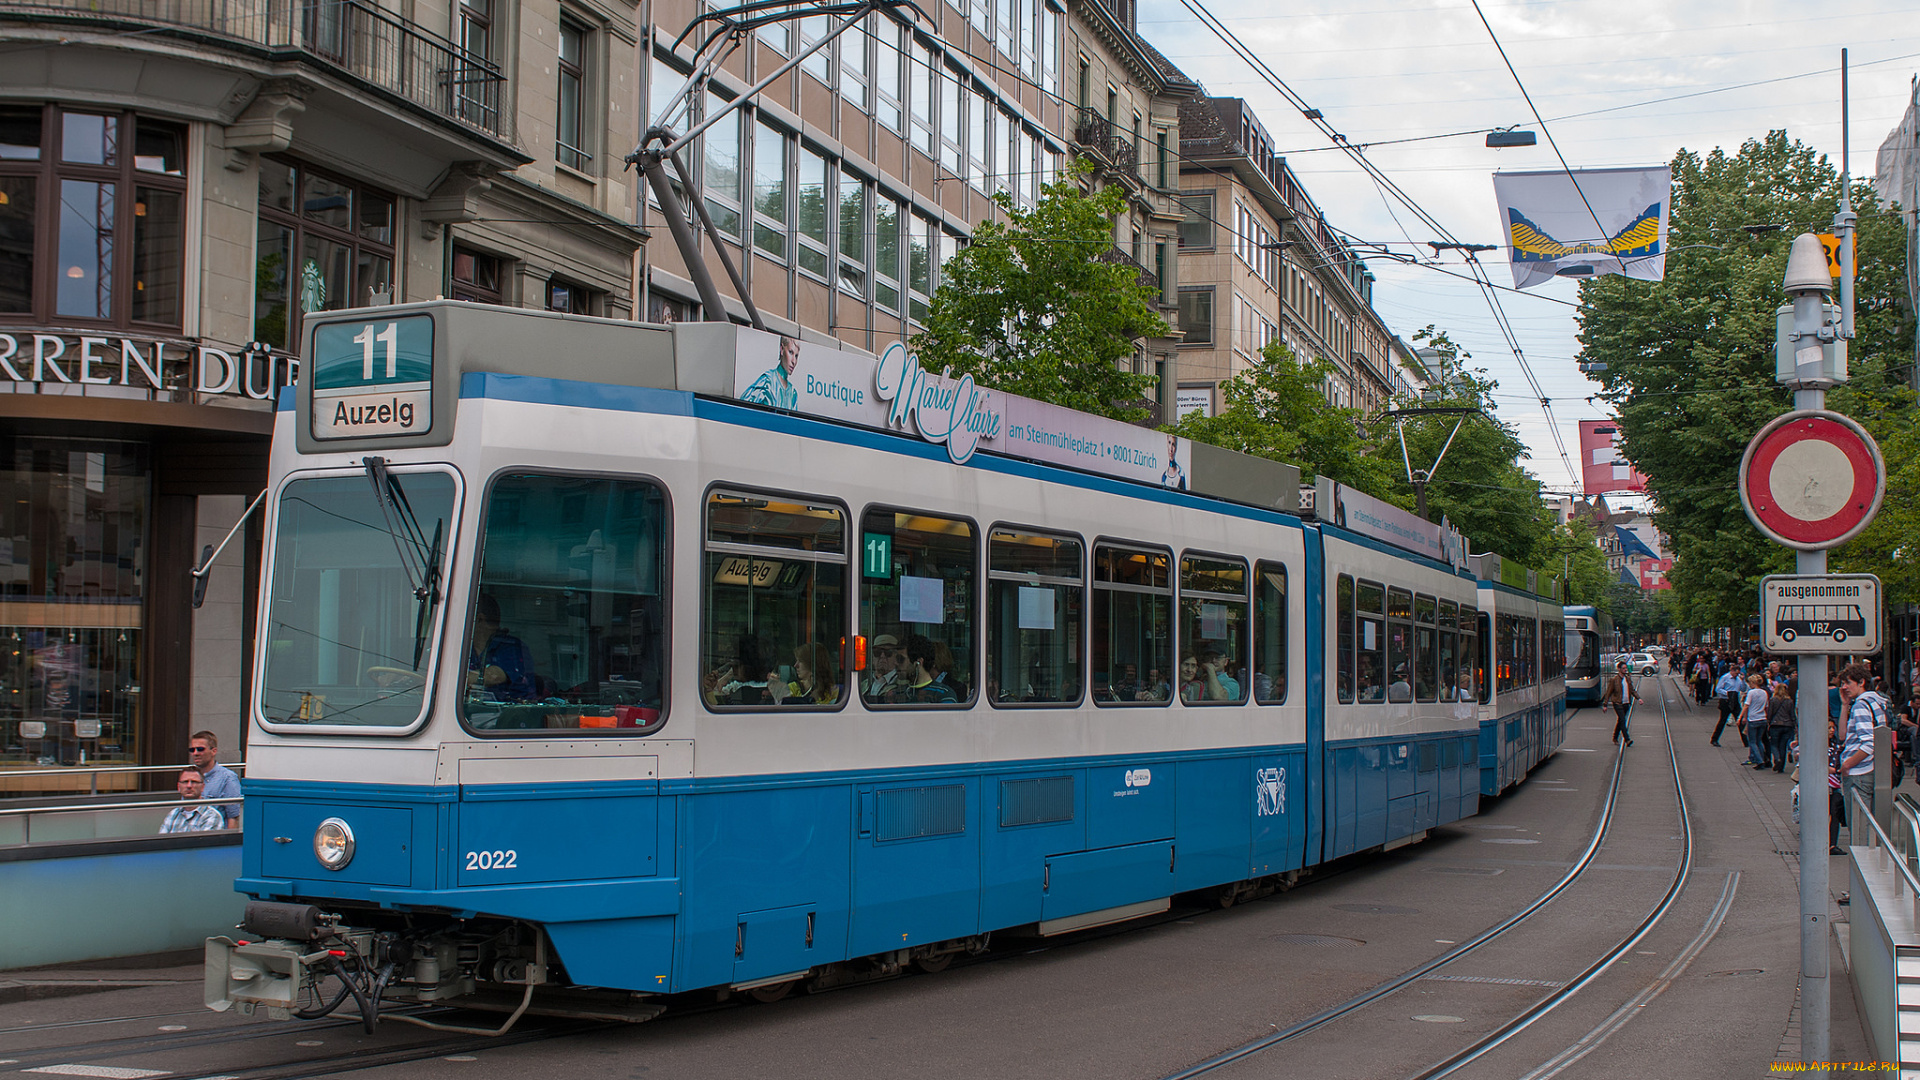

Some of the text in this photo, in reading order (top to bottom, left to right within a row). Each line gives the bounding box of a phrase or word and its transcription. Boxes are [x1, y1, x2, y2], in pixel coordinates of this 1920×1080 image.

[353, 322, 397, 380] 11
[333, 397, 414, 428] Auzelg
[806, 343, 1157, 469] Boutique Marie Claire am Steinmühleplatz 1 8001 Zürich
[867, 539, 886, 573] 11
[725, 560, 800, 583] Auzelg 11
[1777, 585, 1860, 599] ausgenommen
[1809, 622, 1830, 634] VBZ
[465, 849, 517, 871] 2022
